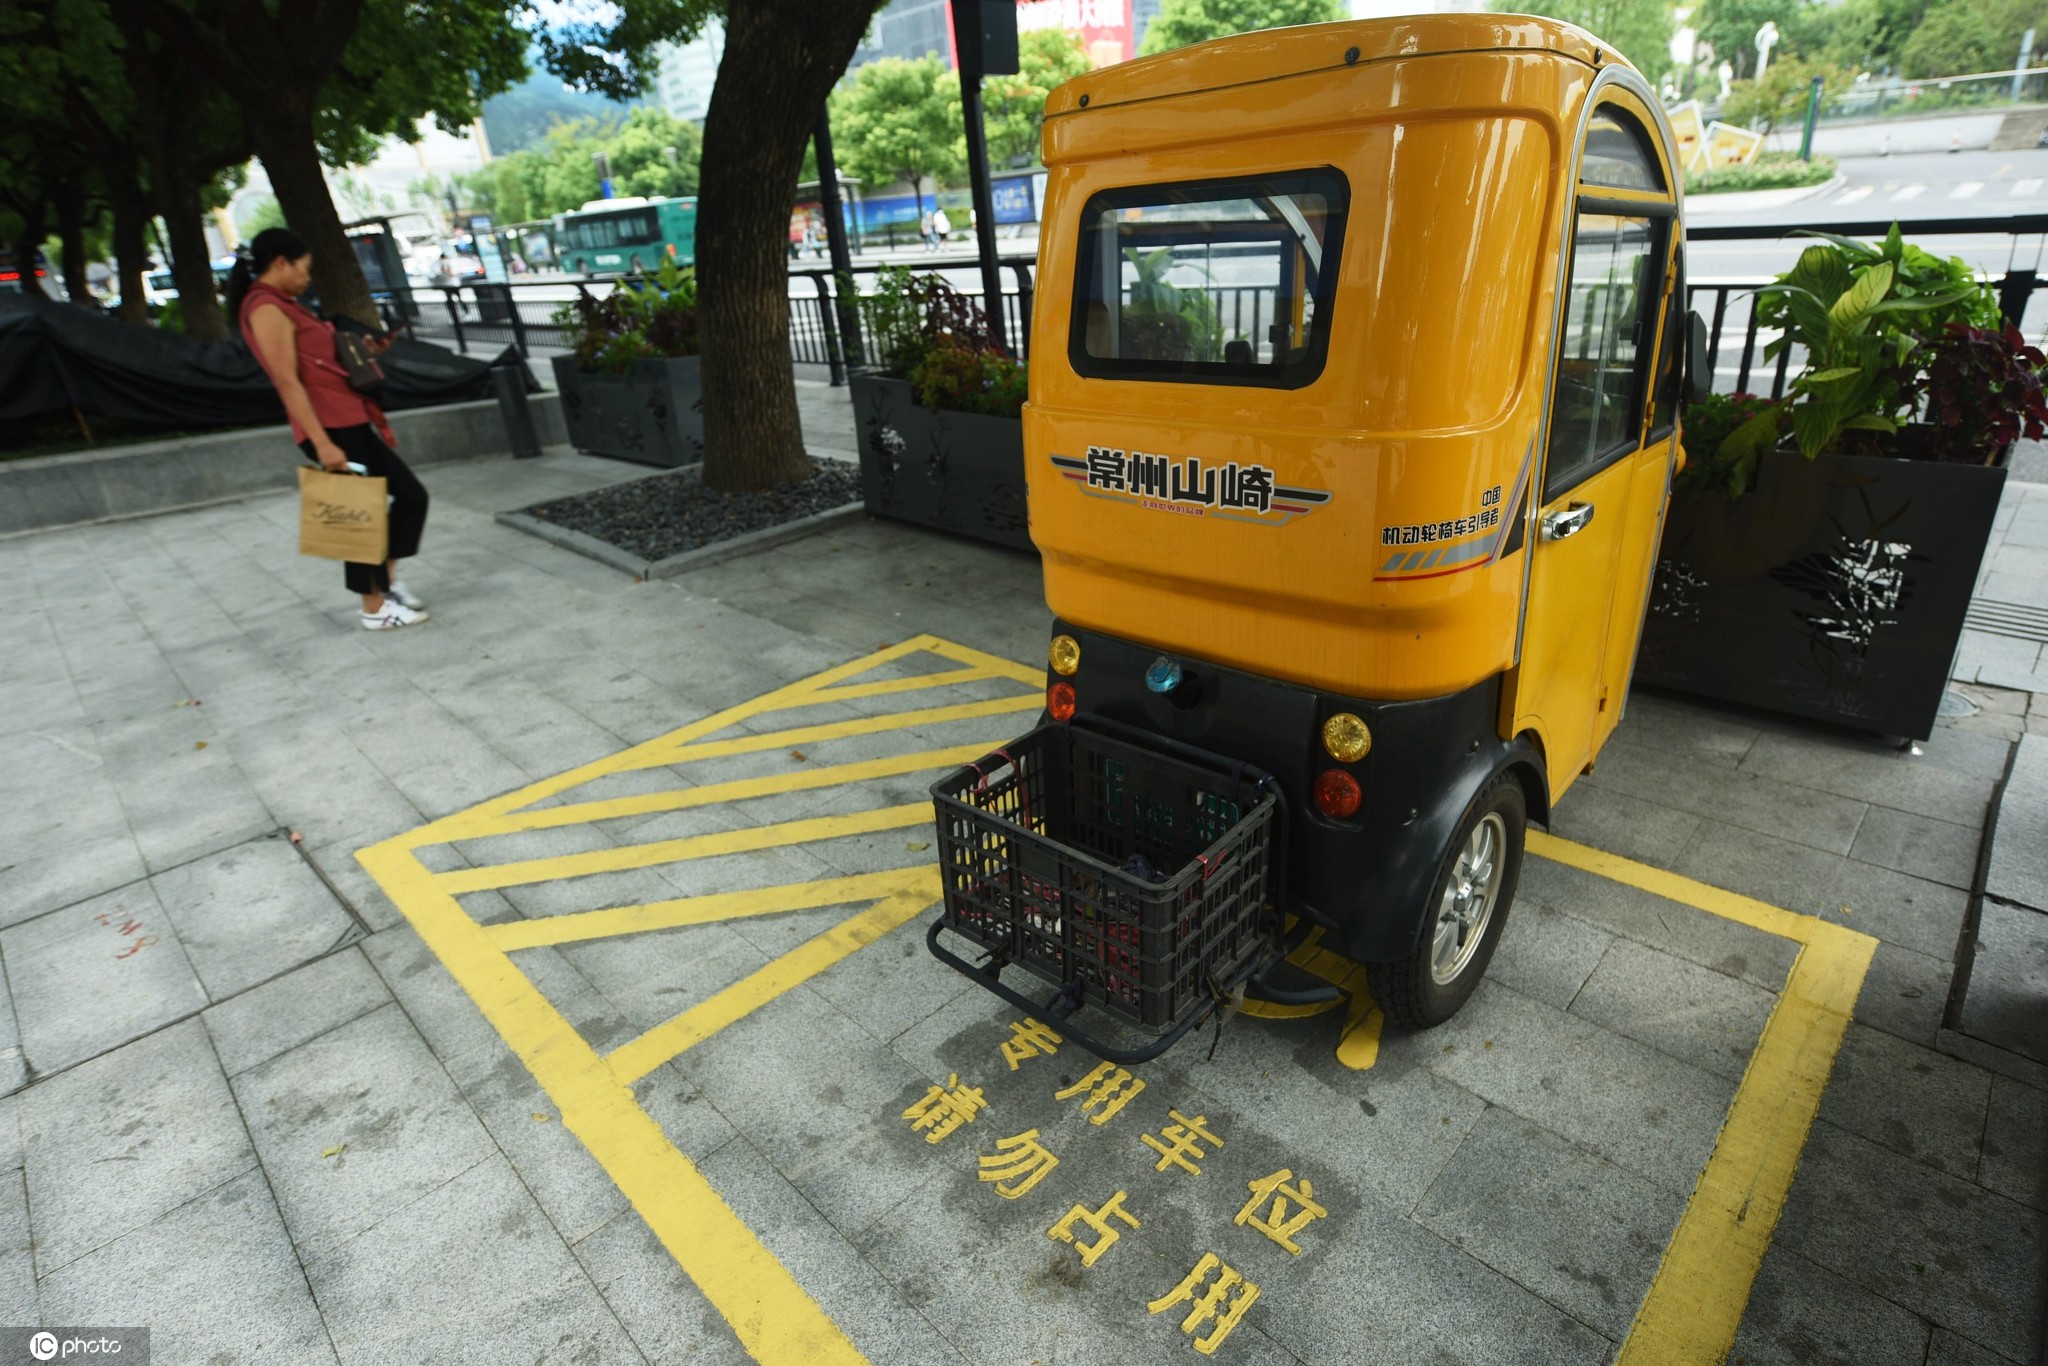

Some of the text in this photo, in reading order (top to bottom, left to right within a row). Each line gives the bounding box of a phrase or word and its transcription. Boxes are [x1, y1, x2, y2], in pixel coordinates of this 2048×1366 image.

[1087, 445, 1275, 514] 常州山崎
[1481, 485, 1502, 507] 中国
[1382, 507, 1500, 547] 机动轮椅车引导者
[999, 1016, 1328, 1256] 专用车位
[901, 1073, 1262, 1356] 请勿占用
